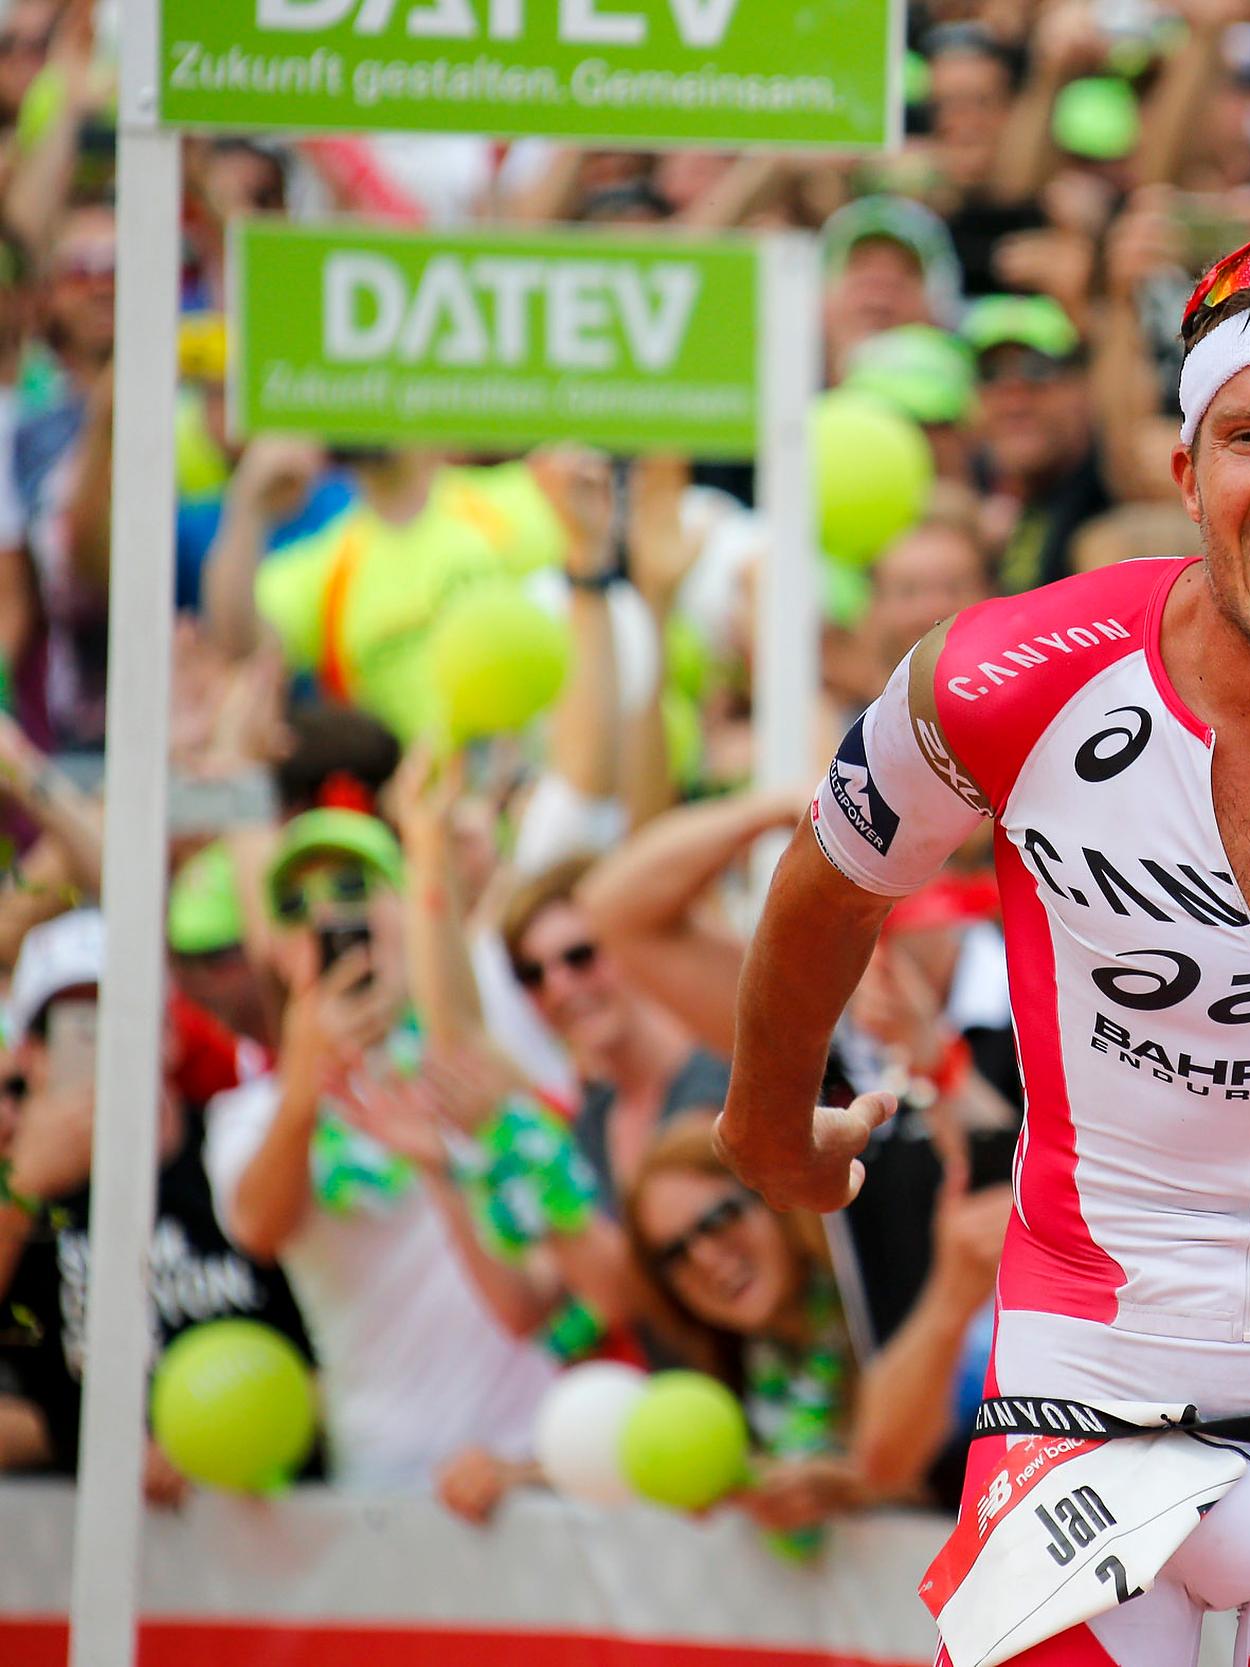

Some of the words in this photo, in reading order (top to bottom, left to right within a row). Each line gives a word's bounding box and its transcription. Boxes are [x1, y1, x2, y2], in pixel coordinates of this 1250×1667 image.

[170, 40, 344, 97] Zukunft
[353, 54, 567, 107] gestalten.
[322, 250, 699, 373] DATEV
[948, 618, 1131, 701] CANYON
[1015, 1449, 1045, 1487] new
[1034, 1485, 1117, 1566] Jan
[1095, 1555, 1144, 1605] 2
